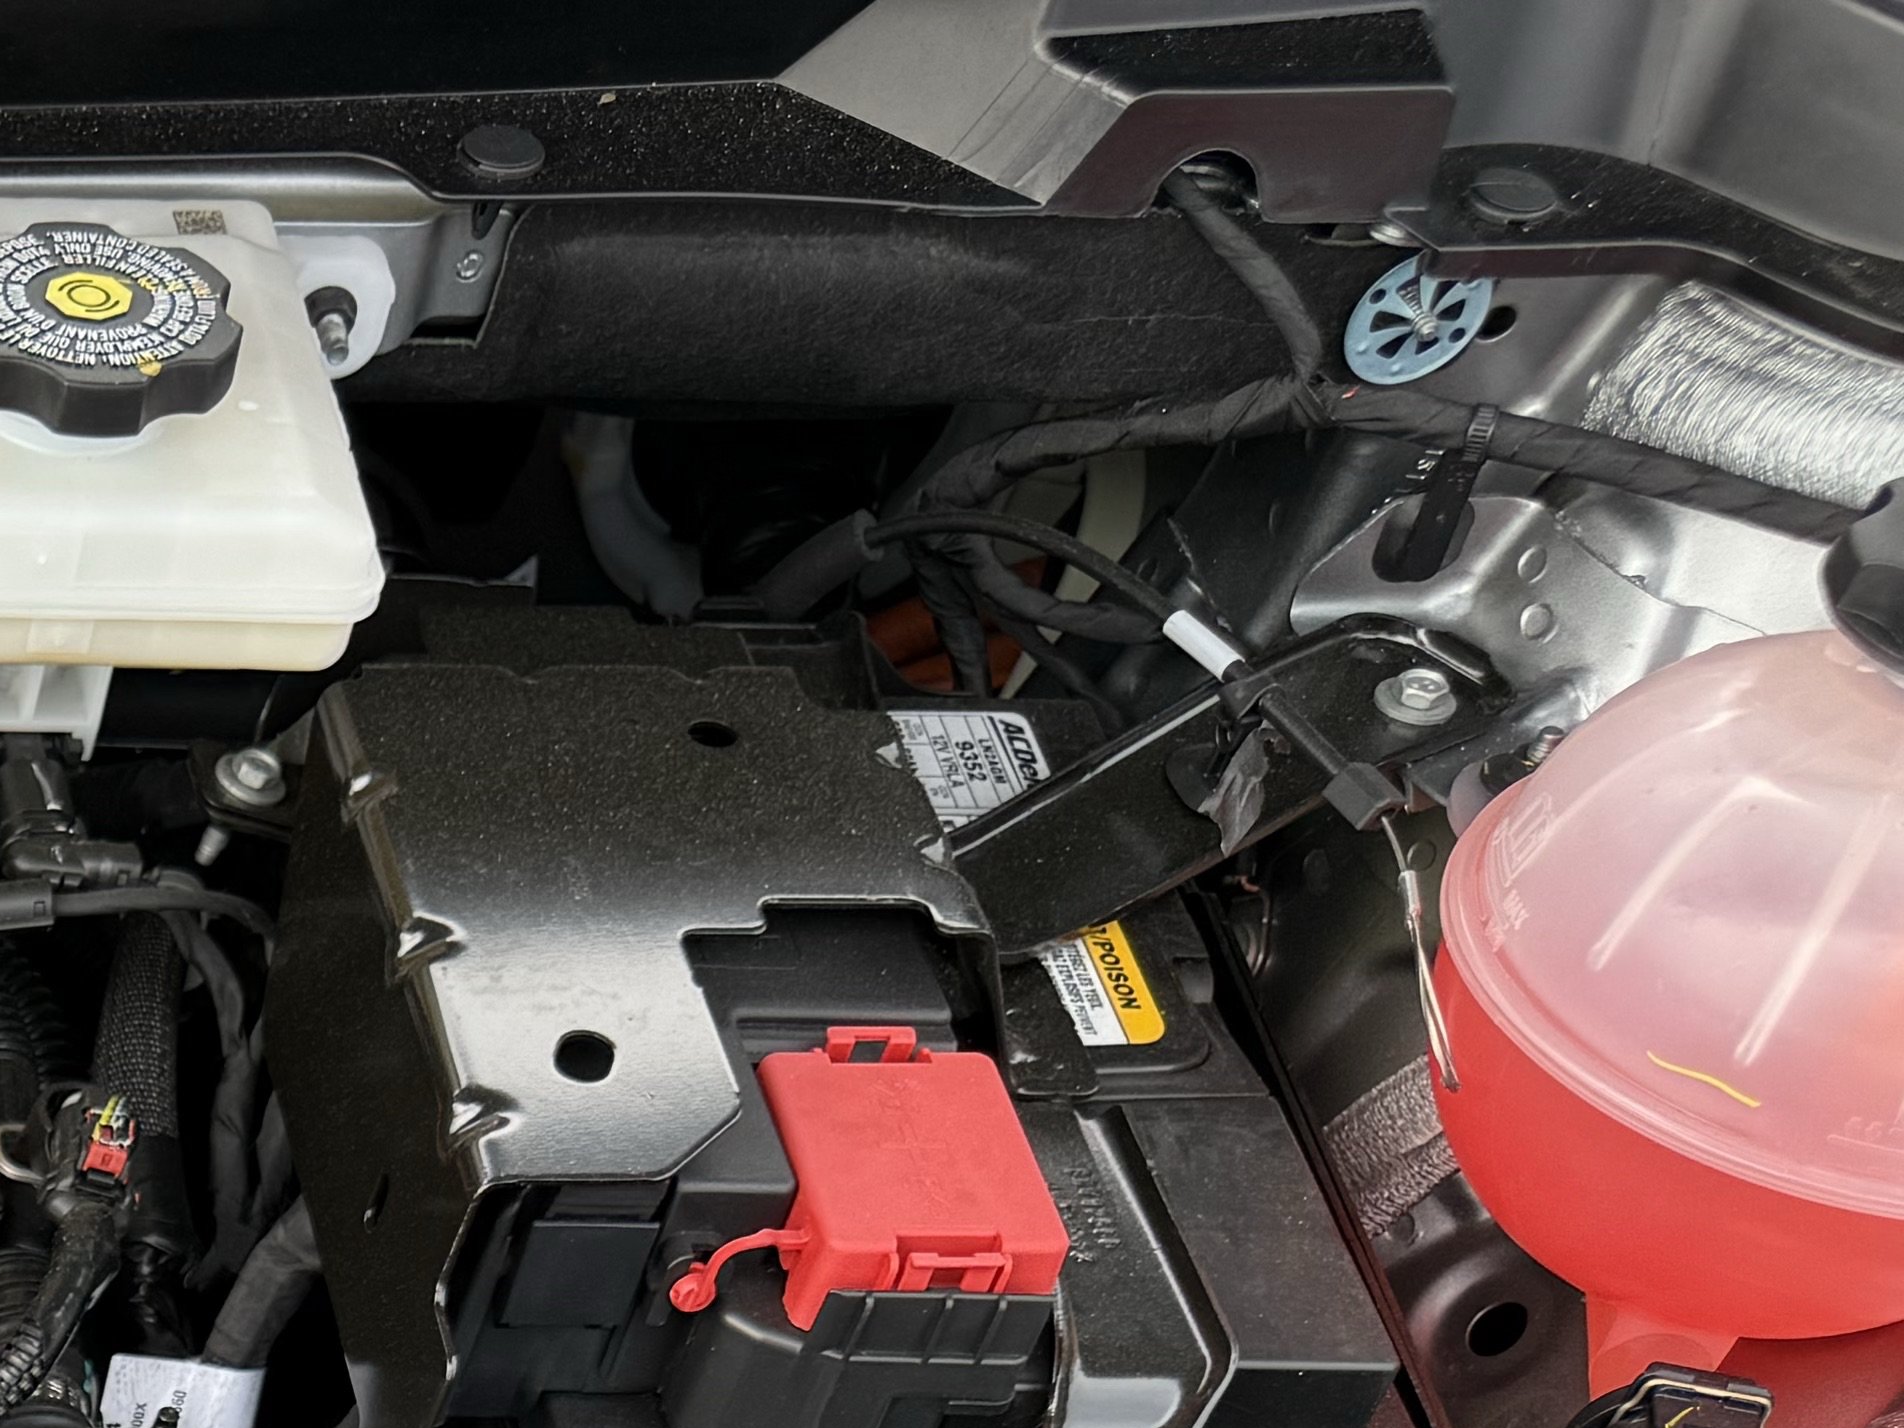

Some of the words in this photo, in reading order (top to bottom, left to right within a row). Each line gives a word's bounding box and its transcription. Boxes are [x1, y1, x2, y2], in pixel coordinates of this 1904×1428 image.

[49, 242, 91, 256] ONLY
[33, 330, 72, 349] QUE
[50, 323, 151, 341] PROVENANT
[11, 337, 96, 365] NETTOYER
[930, 733, 952, 753] 12V
[941, 756, 965, 788] VRLA
[954, 741, 988, 783] 9352
